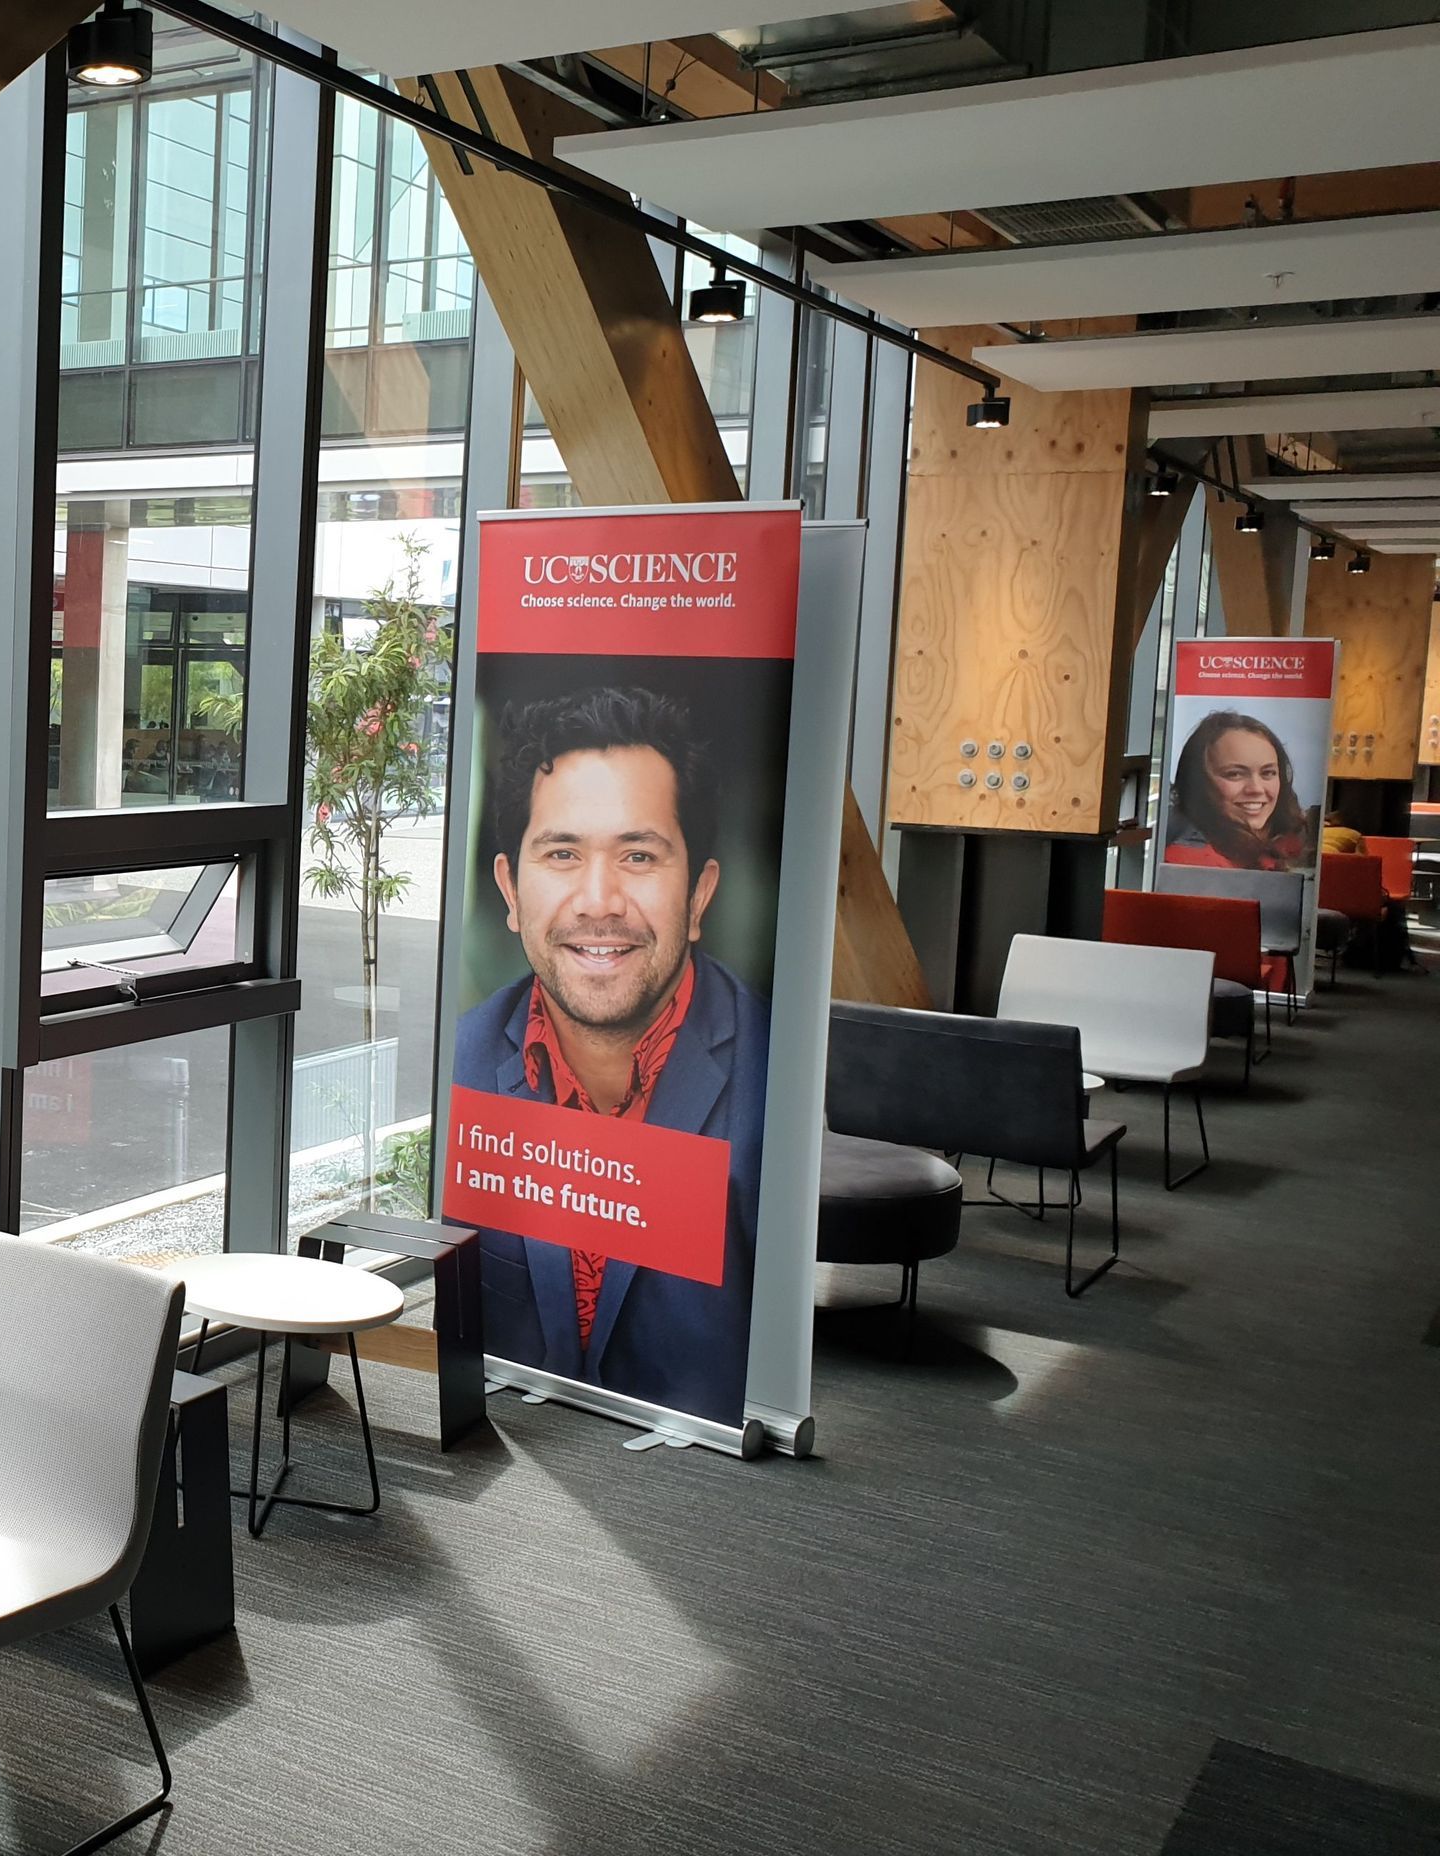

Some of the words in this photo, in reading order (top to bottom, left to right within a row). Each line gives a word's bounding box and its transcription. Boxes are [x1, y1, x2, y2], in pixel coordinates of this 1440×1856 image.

[523, 556, 569, 584] UC
[589, 552, 737, 584] SCIENCE
[521, 594, 564, 607] Choose
[567, 593, 617, 607] science.
[620, 593, 667, 611] Change
[670, 593, 692, 607] the
[696, 593, 736, 607] world.
[1200, 656, 1224, 669] UC
[1233, 656, 1304, 669] SCIENCE
[458, 1123, 464, 1146] I
[469, 1124, 514, 1157] find
[522, 1140, 642, 1186] solutions.
[456, 1162, 463, 1184] I
[468, 1169, 506, 1195] am
[512, 1174, 554, 1206] the
[559, 1183, 648, 1229] future.
